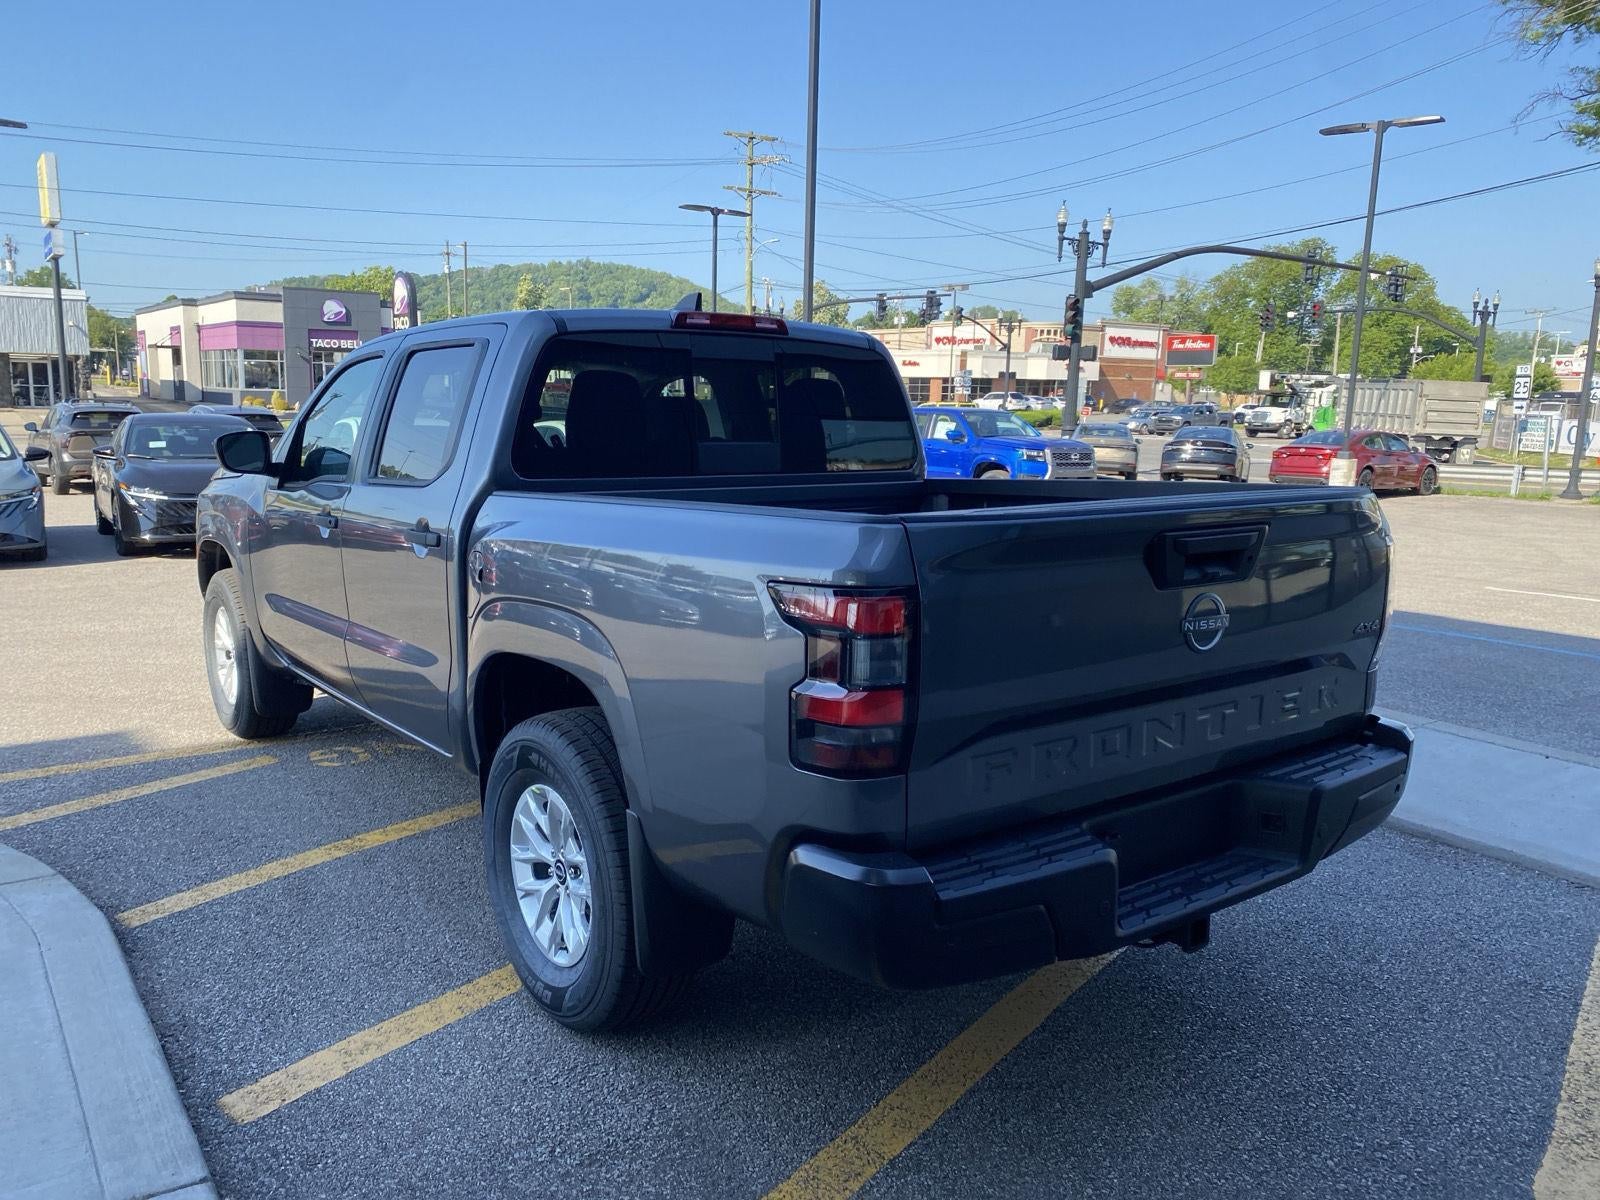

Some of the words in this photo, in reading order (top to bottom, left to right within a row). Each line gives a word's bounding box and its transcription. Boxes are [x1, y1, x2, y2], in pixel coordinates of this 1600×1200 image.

[394, 317, 409, 329] TACO
[310, 339, 338, 348] TACO
[941, 336, 957, 346] CVS
[1172, 339, 1184, 349] Tim
[1185, 339, 1210, 349] Hortons
[1514, 381, 1529, 394] 25
[1184, 617, 1230, 632] NISSAN
[967, 677, 1341, 794] FRONTIER
